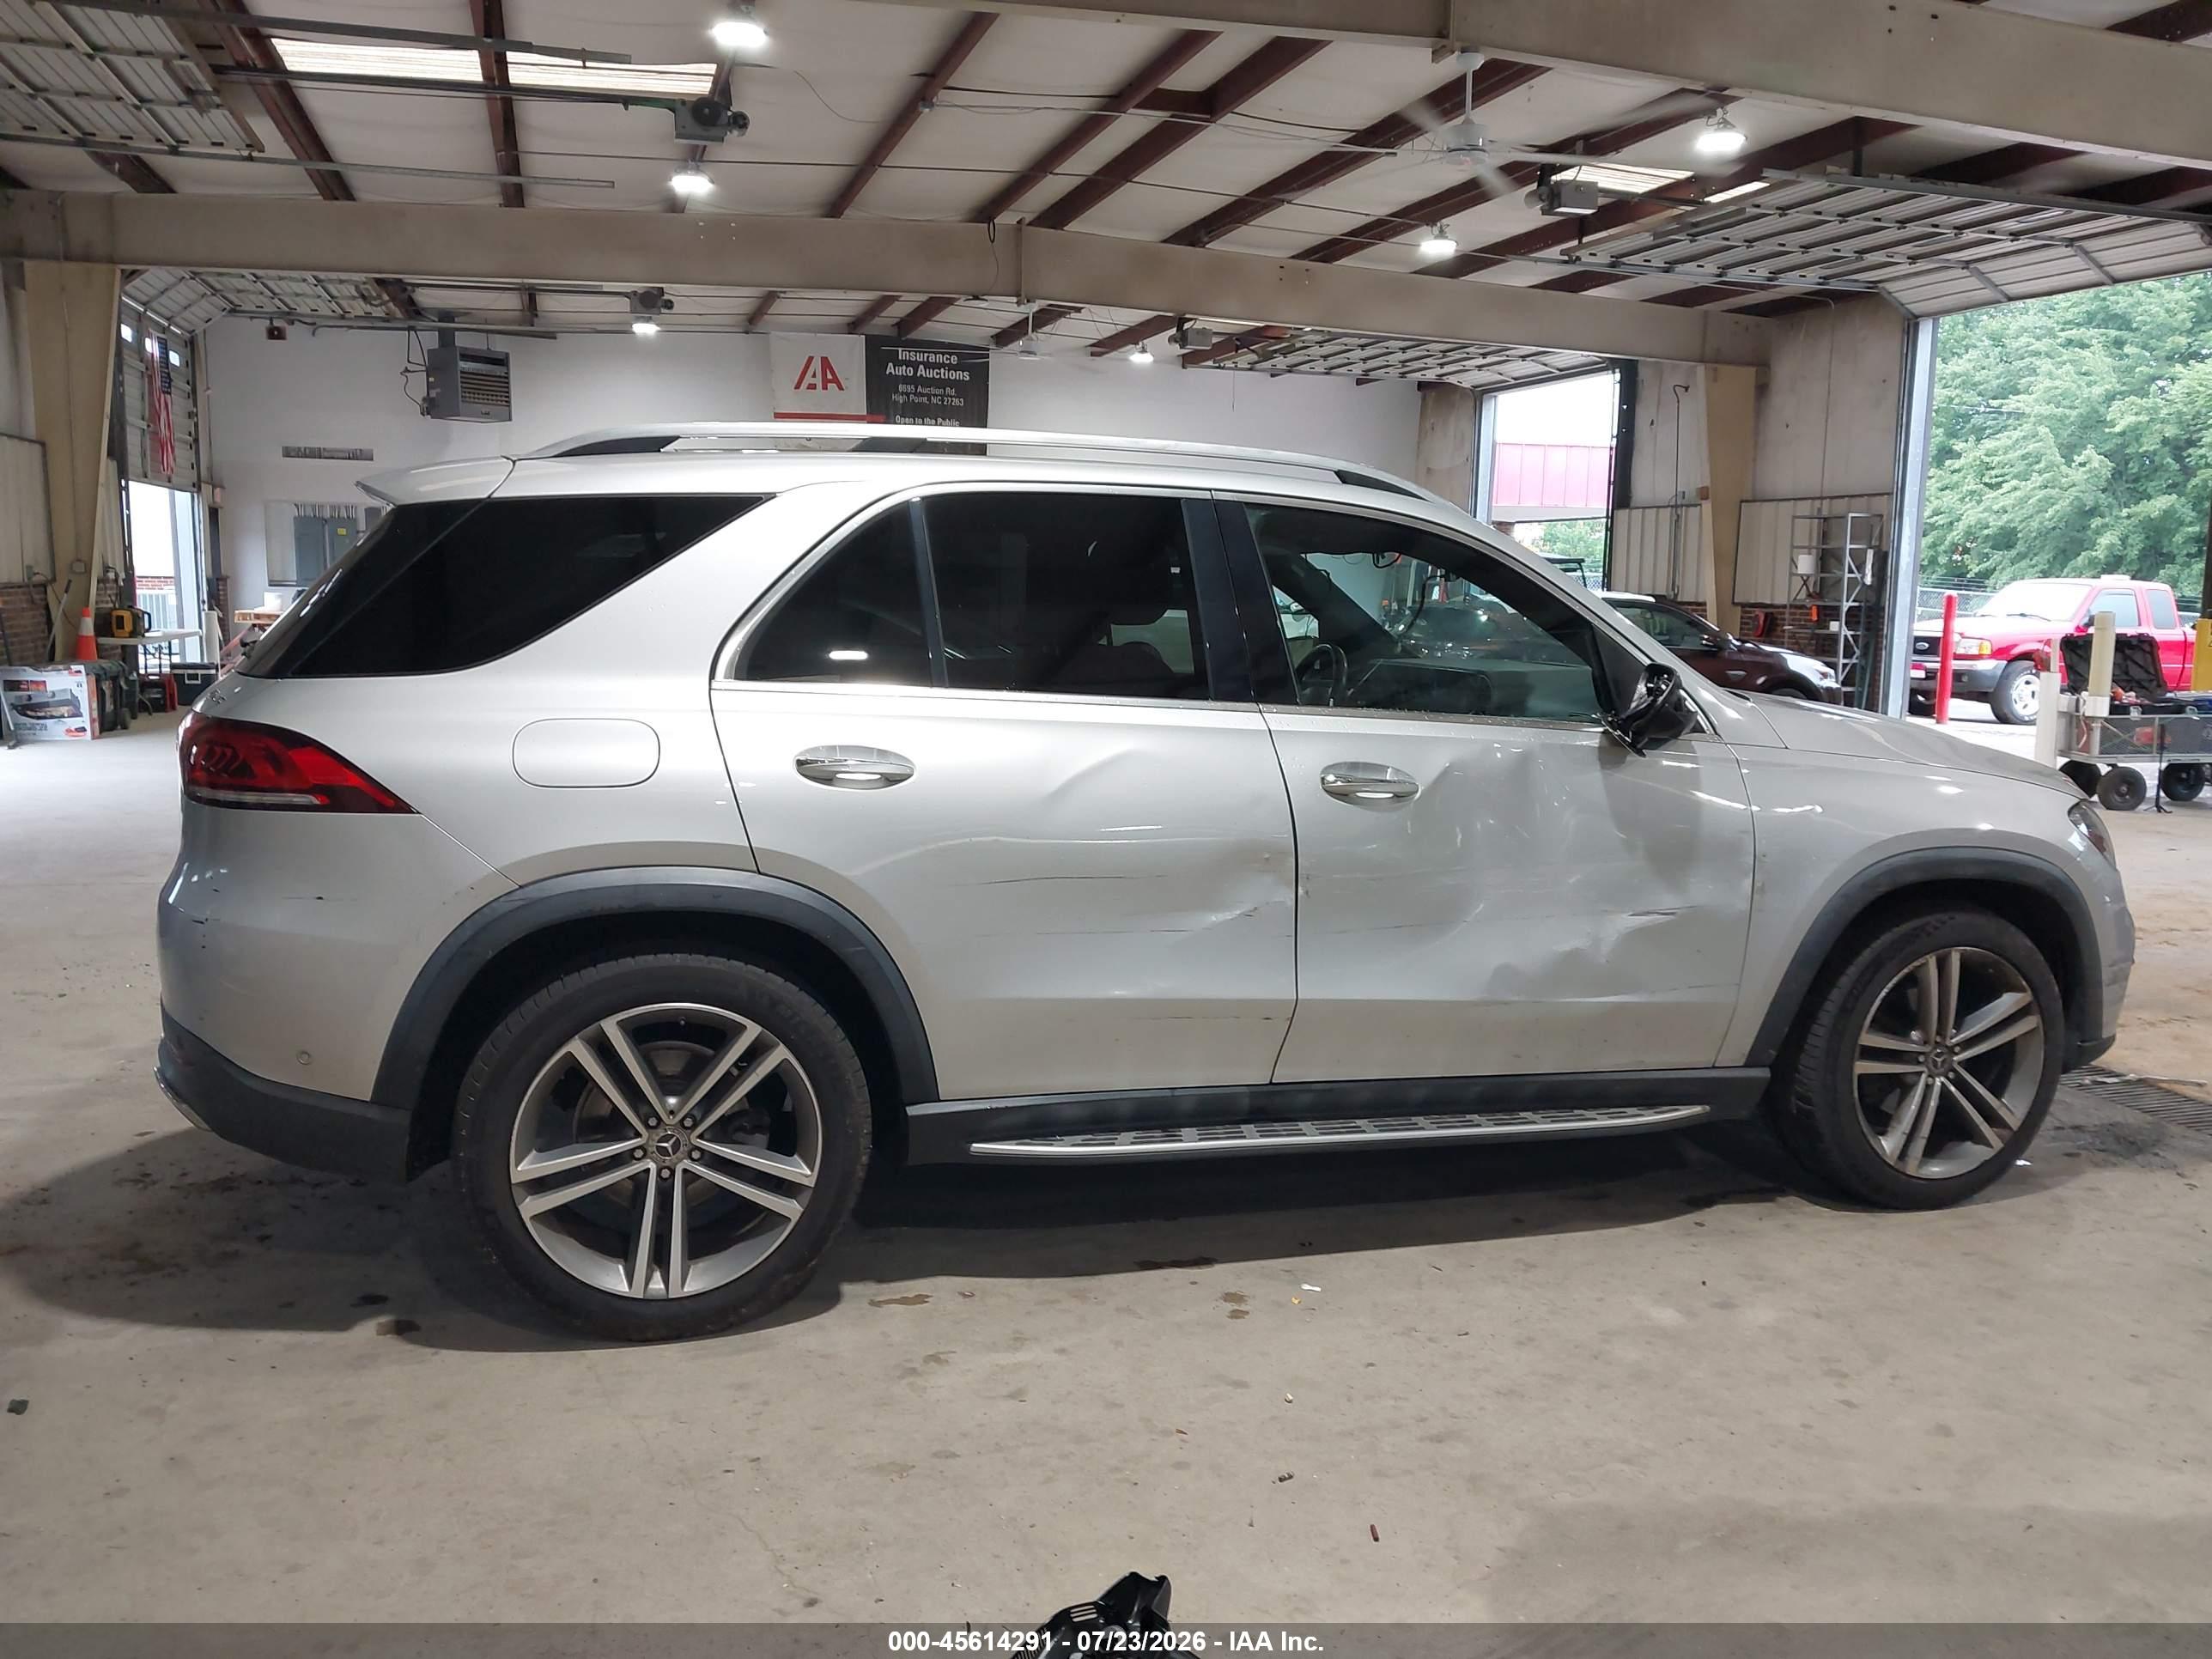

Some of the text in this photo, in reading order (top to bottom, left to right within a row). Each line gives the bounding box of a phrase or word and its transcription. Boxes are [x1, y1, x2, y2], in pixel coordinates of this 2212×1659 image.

[898, 349, 958, 365] Insurance
[885, 362, 970, 380] Auto Auctions
[917, 385, 945, 395] Auction
[891, 393, 908, 404] High
[931, 396, 942, 404] NC
[943, 397, 964, 406] 27263
[895, 415, 915, 425] Open
[924, 417, 936, 426] the
[937, 417, 960, 428] Public
